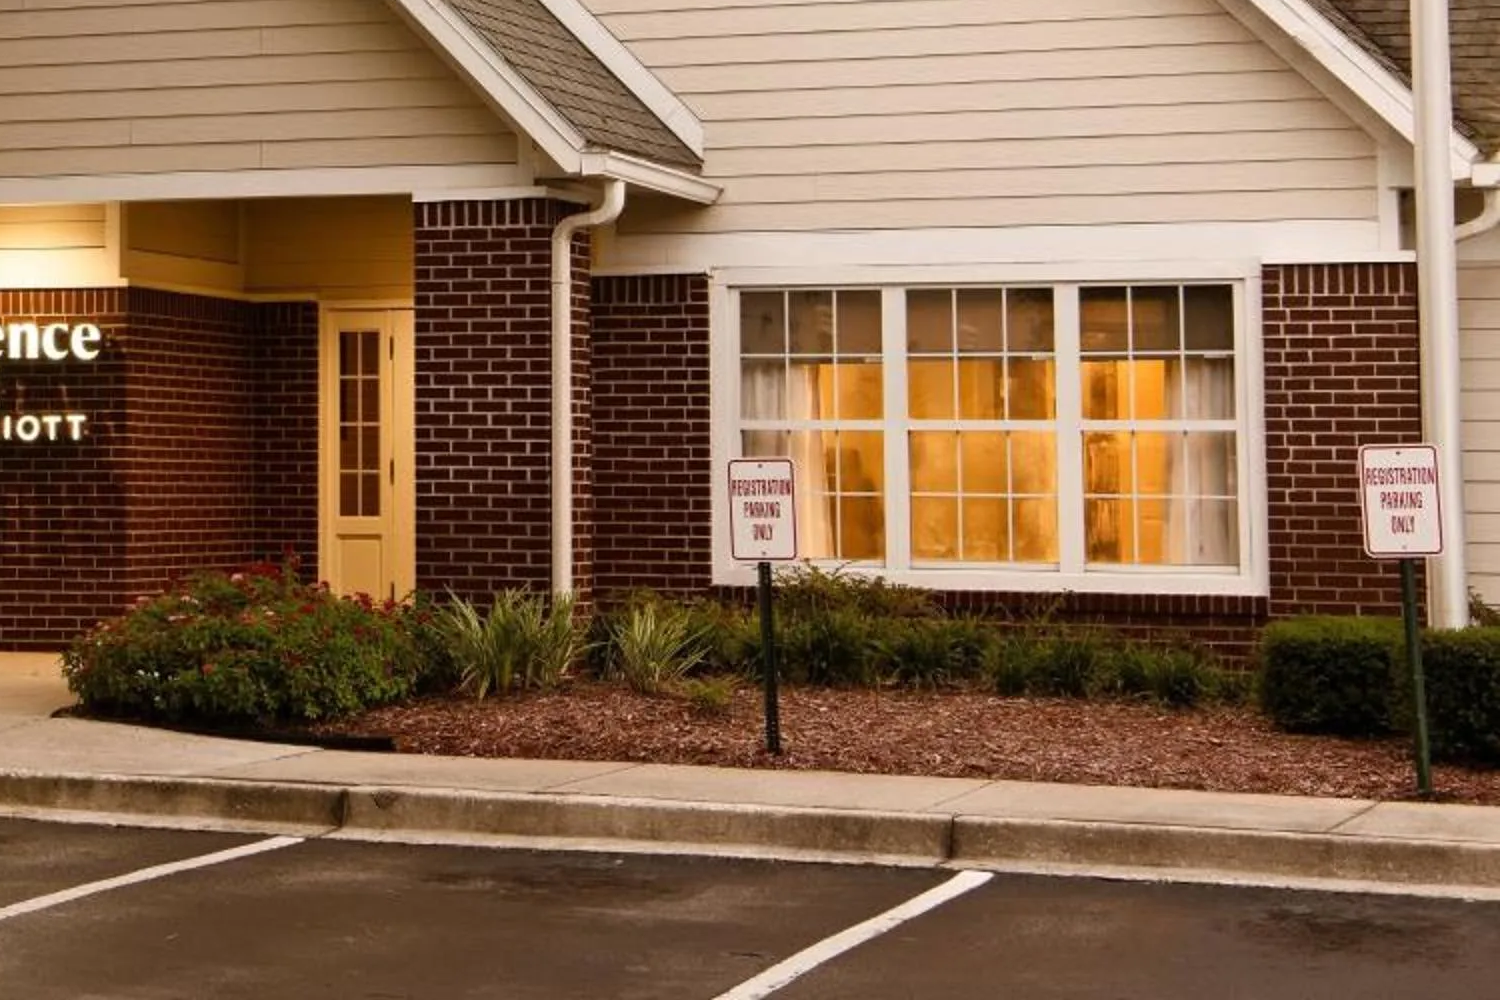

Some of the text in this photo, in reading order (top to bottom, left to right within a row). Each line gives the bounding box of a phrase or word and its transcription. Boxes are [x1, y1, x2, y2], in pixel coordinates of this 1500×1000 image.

[1365, 467, 1435, 485] REGISTRATION
[731, 479, 791, 496] REGISTRATION
[1380, 491, 1423, 509] PARKING
[743, 501, 781, 518] PARKING
[752, 523, 773, 540] ONLY
[1391, 515, 1415, 534] ONLY
